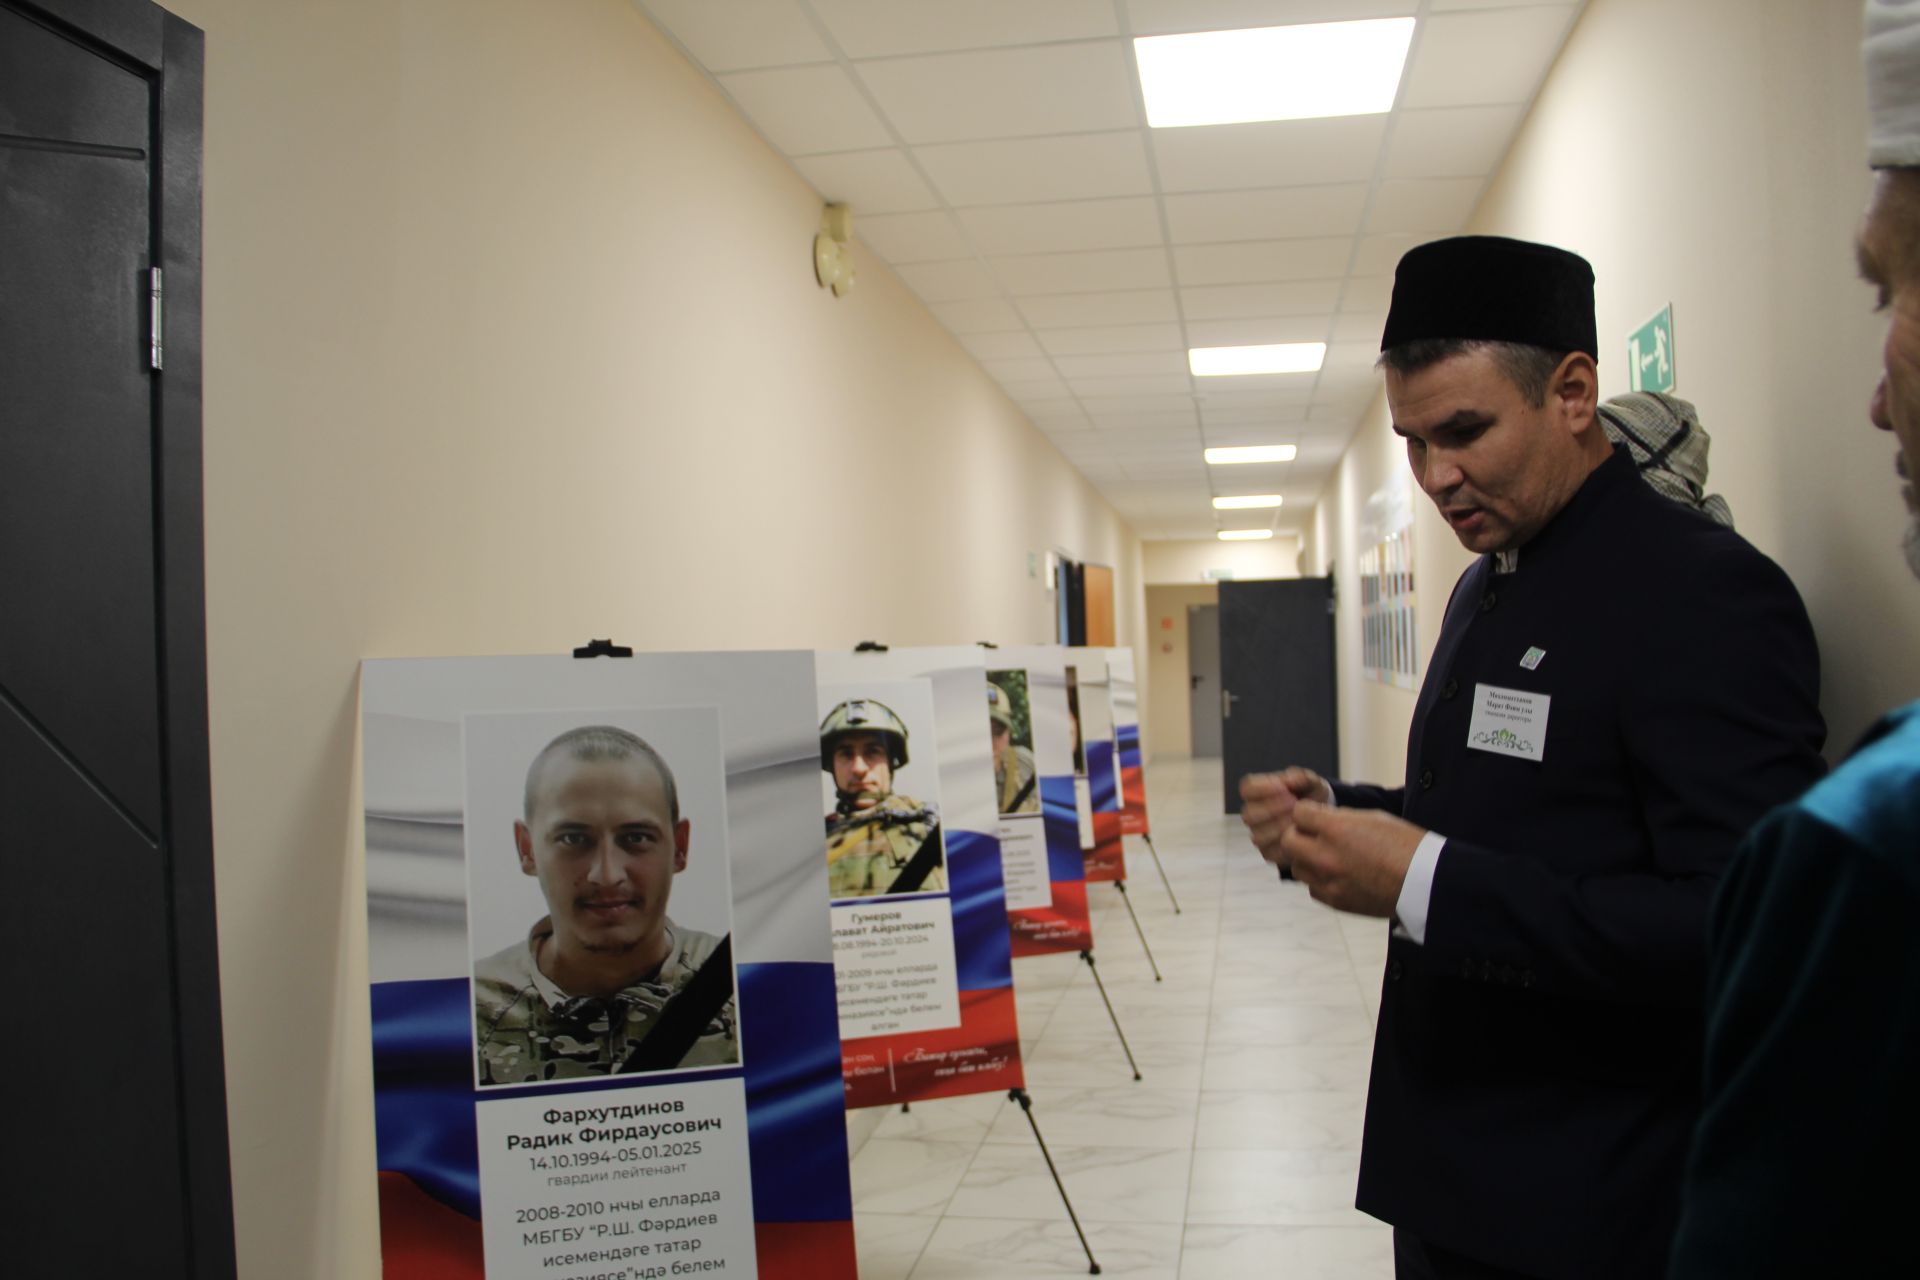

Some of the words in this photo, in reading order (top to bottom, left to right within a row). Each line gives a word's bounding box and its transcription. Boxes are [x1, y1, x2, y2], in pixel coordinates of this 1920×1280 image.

[851, 911, 902, 924] Гумеров
[871, 921, 935, 934] Айратович
[543, 1100, 685, 1126] Фархутдинов
[507, 1132, 573, 1150] Радик
[579, 1118, 722, 1143] Фирдаусович
[529, 1141, 702, 1170] 14.10.1994-05.01.2025
[547, 1170, 609, 1186] гвардии
[612, 1162, 687, 1180] лейтенант
[516, 1201, 604, 1224] 2008-2010
[610, 1200, 644, 1213] нчы
[649, 1189, 721, 1209] елларда
[523, 1226, 584, 1246] МБГБУ
[638, 1213, 718, 1232] Фәрдиев
[543, 1244, 650, 1268] исемендәге
[654, 1237, 702, 1255] татар
[671, 1257, 726, 1275] белем
